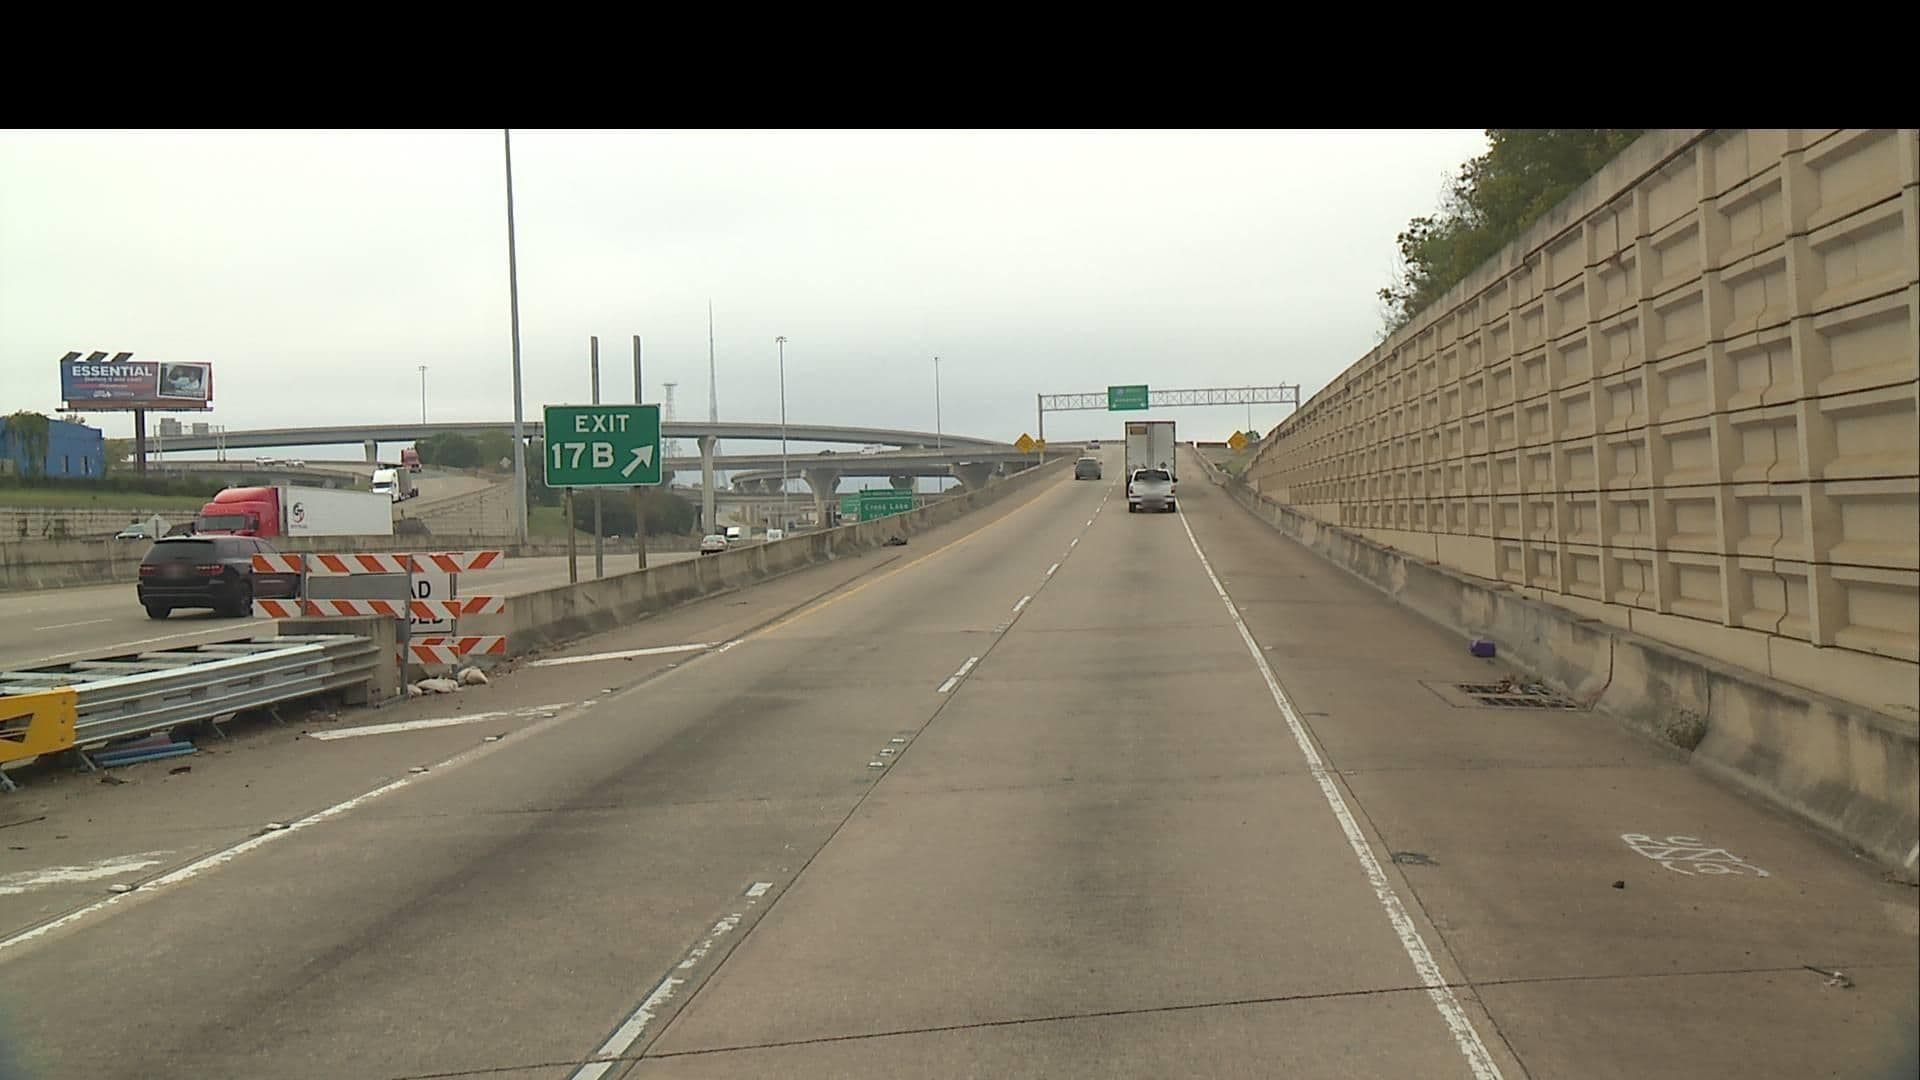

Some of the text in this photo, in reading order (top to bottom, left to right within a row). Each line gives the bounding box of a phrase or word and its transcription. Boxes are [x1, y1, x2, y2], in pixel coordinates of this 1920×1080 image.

[72, 365, 152, 376] ESSENTIAL
[575, 414, 630, 432] EXIT
[552, 442, 615, 469] 17B
